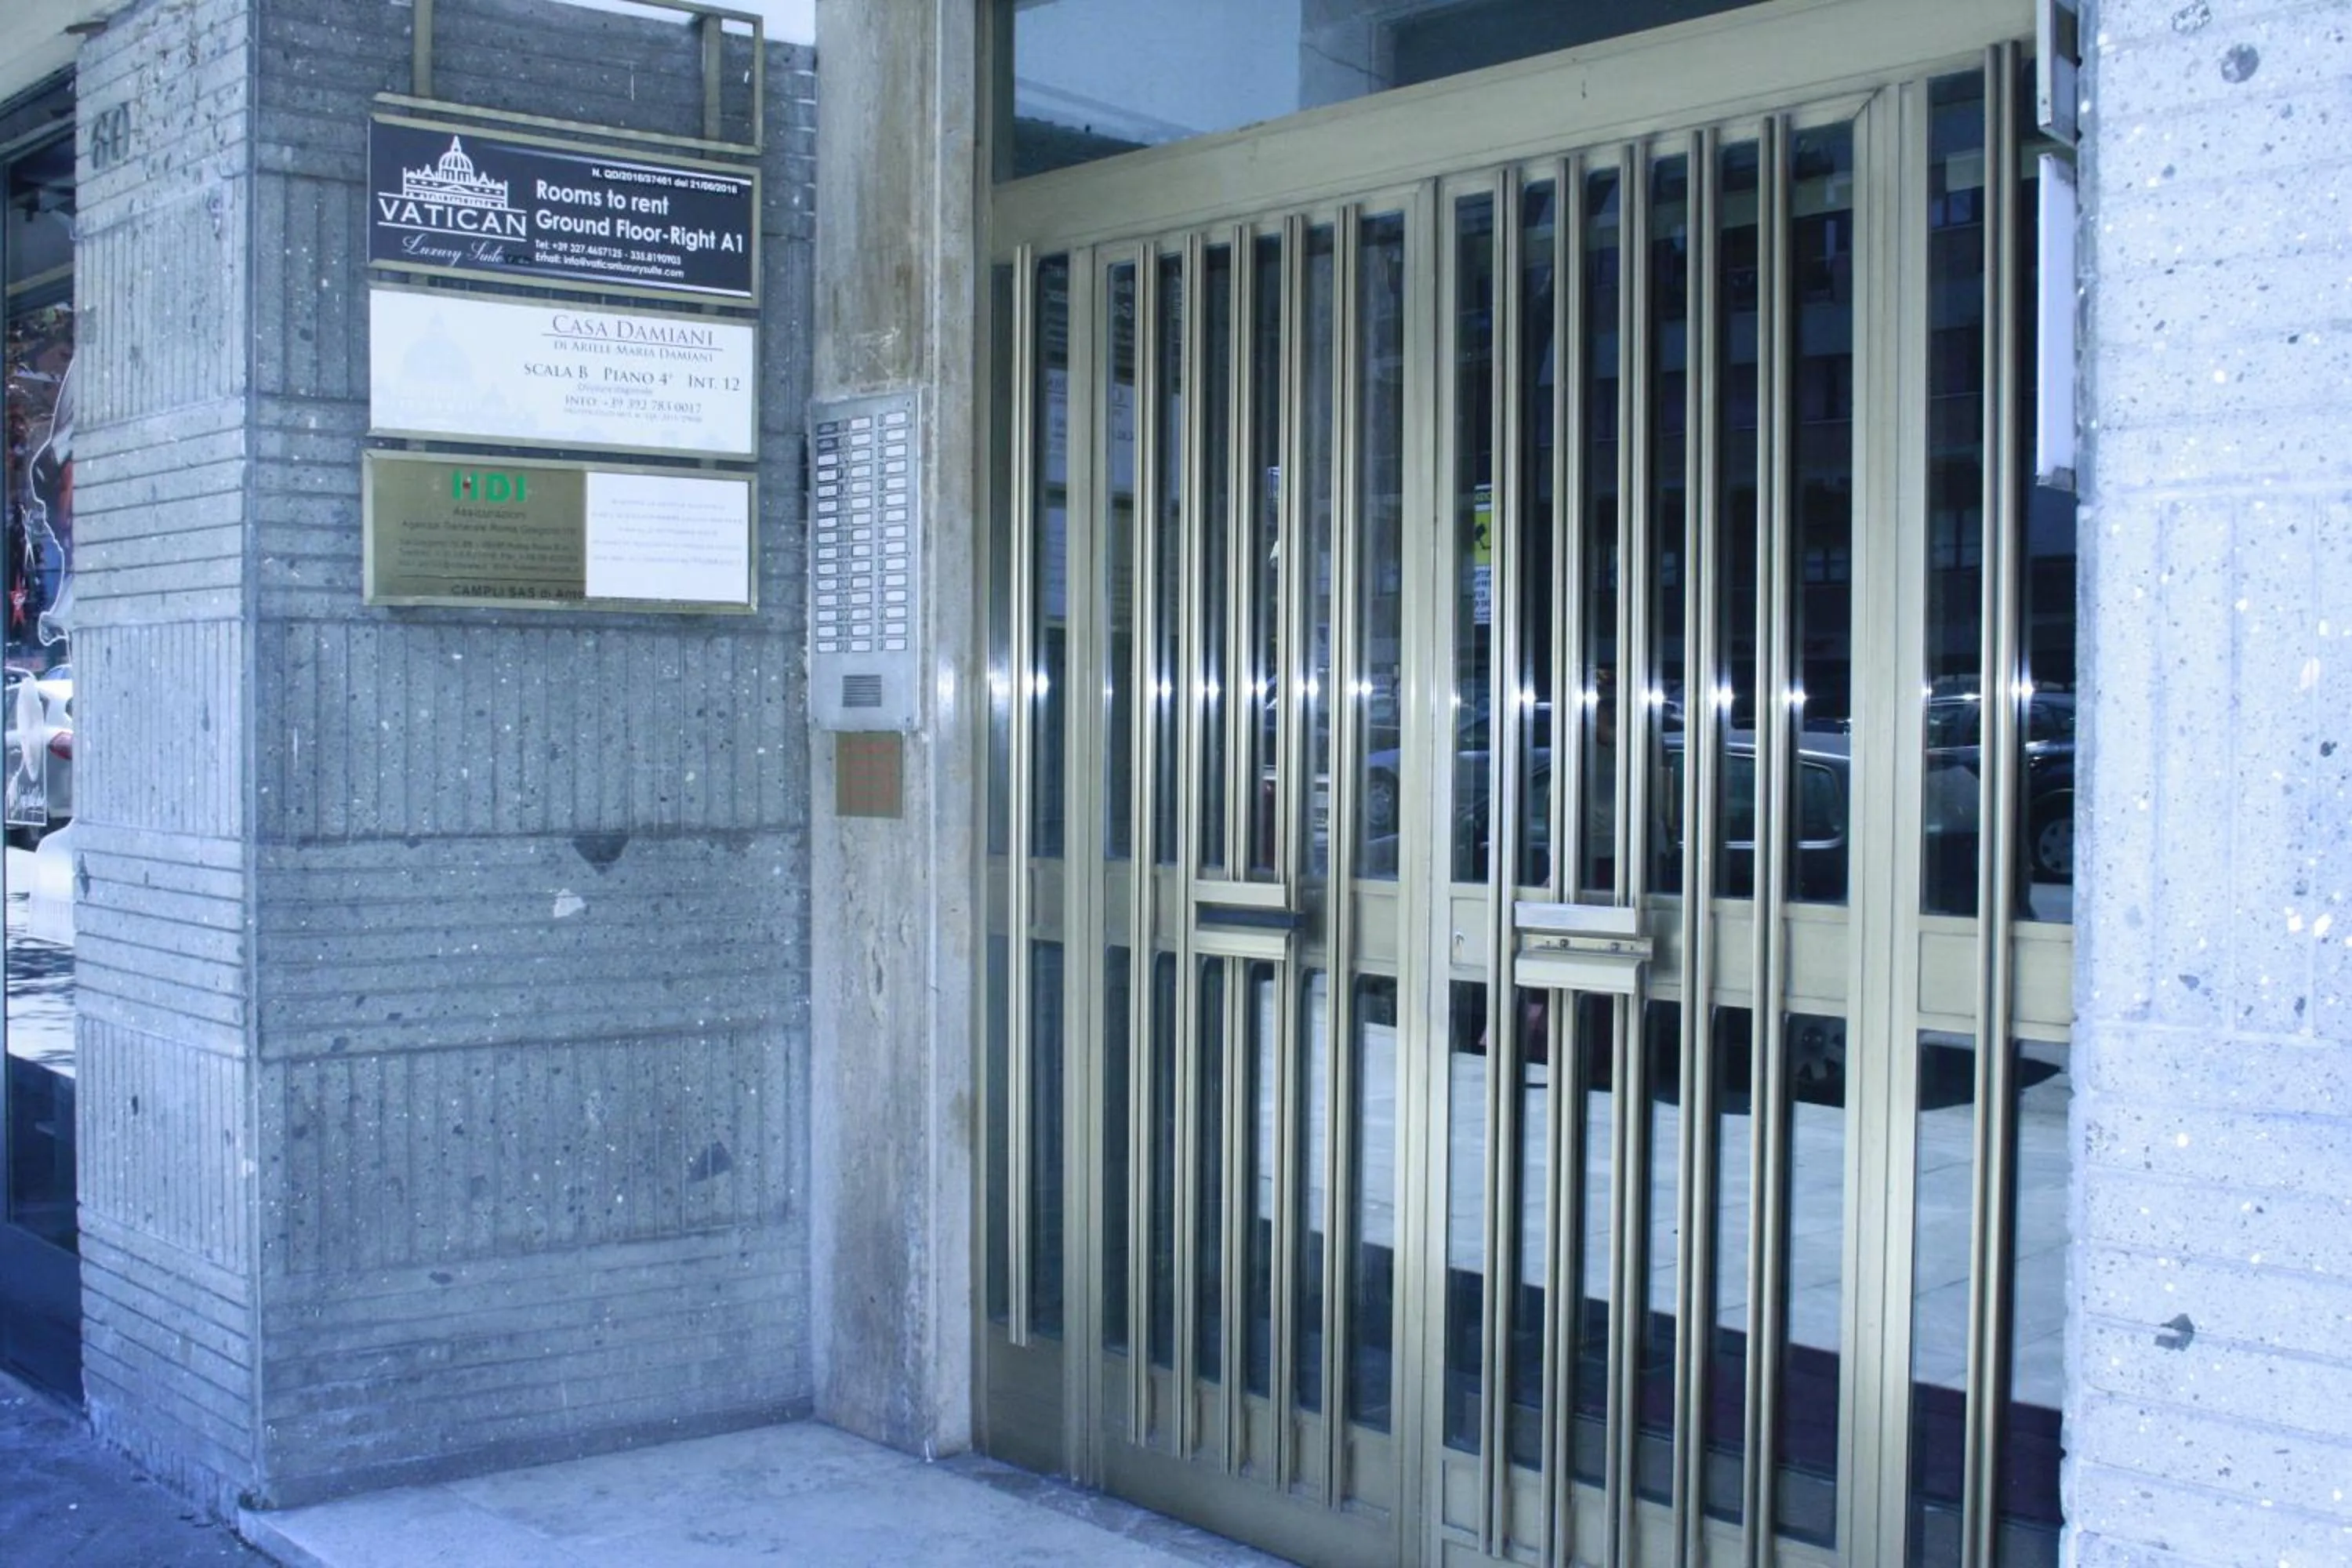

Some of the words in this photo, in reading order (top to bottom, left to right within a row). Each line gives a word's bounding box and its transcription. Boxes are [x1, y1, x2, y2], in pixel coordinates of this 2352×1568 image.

[535, 180, 602, 207] Rooms
[608, 190, 626, 210] to
[631, 195, 670, 216] rent
[379, 197, 527, 237] VATICAN
[535, 209, 610, 236] Ground
[616, 219, 716, 252] Floor-Right
[721, 232, 743, 253] A1
[401, 233, 462, 267] Luxury
[466, 239, 505, 263] Suite
[553, 314, 608, 339] CASA
[616, 321, 713, 347] DAMIANI
[554, 339, 568, 351] DI
[615, 345, 656, 359] MARIA
[659, 347, 713, 363] DAMIANI
[524, 363, 572, 379] SCALA
[579, 365, 588, 379] B
[604, 366, 655, 386] PIANO
[688, 374, 717, 390] INT.
[724, 376, 740, 391] 12
[451, 468, 528, 503] HDI
